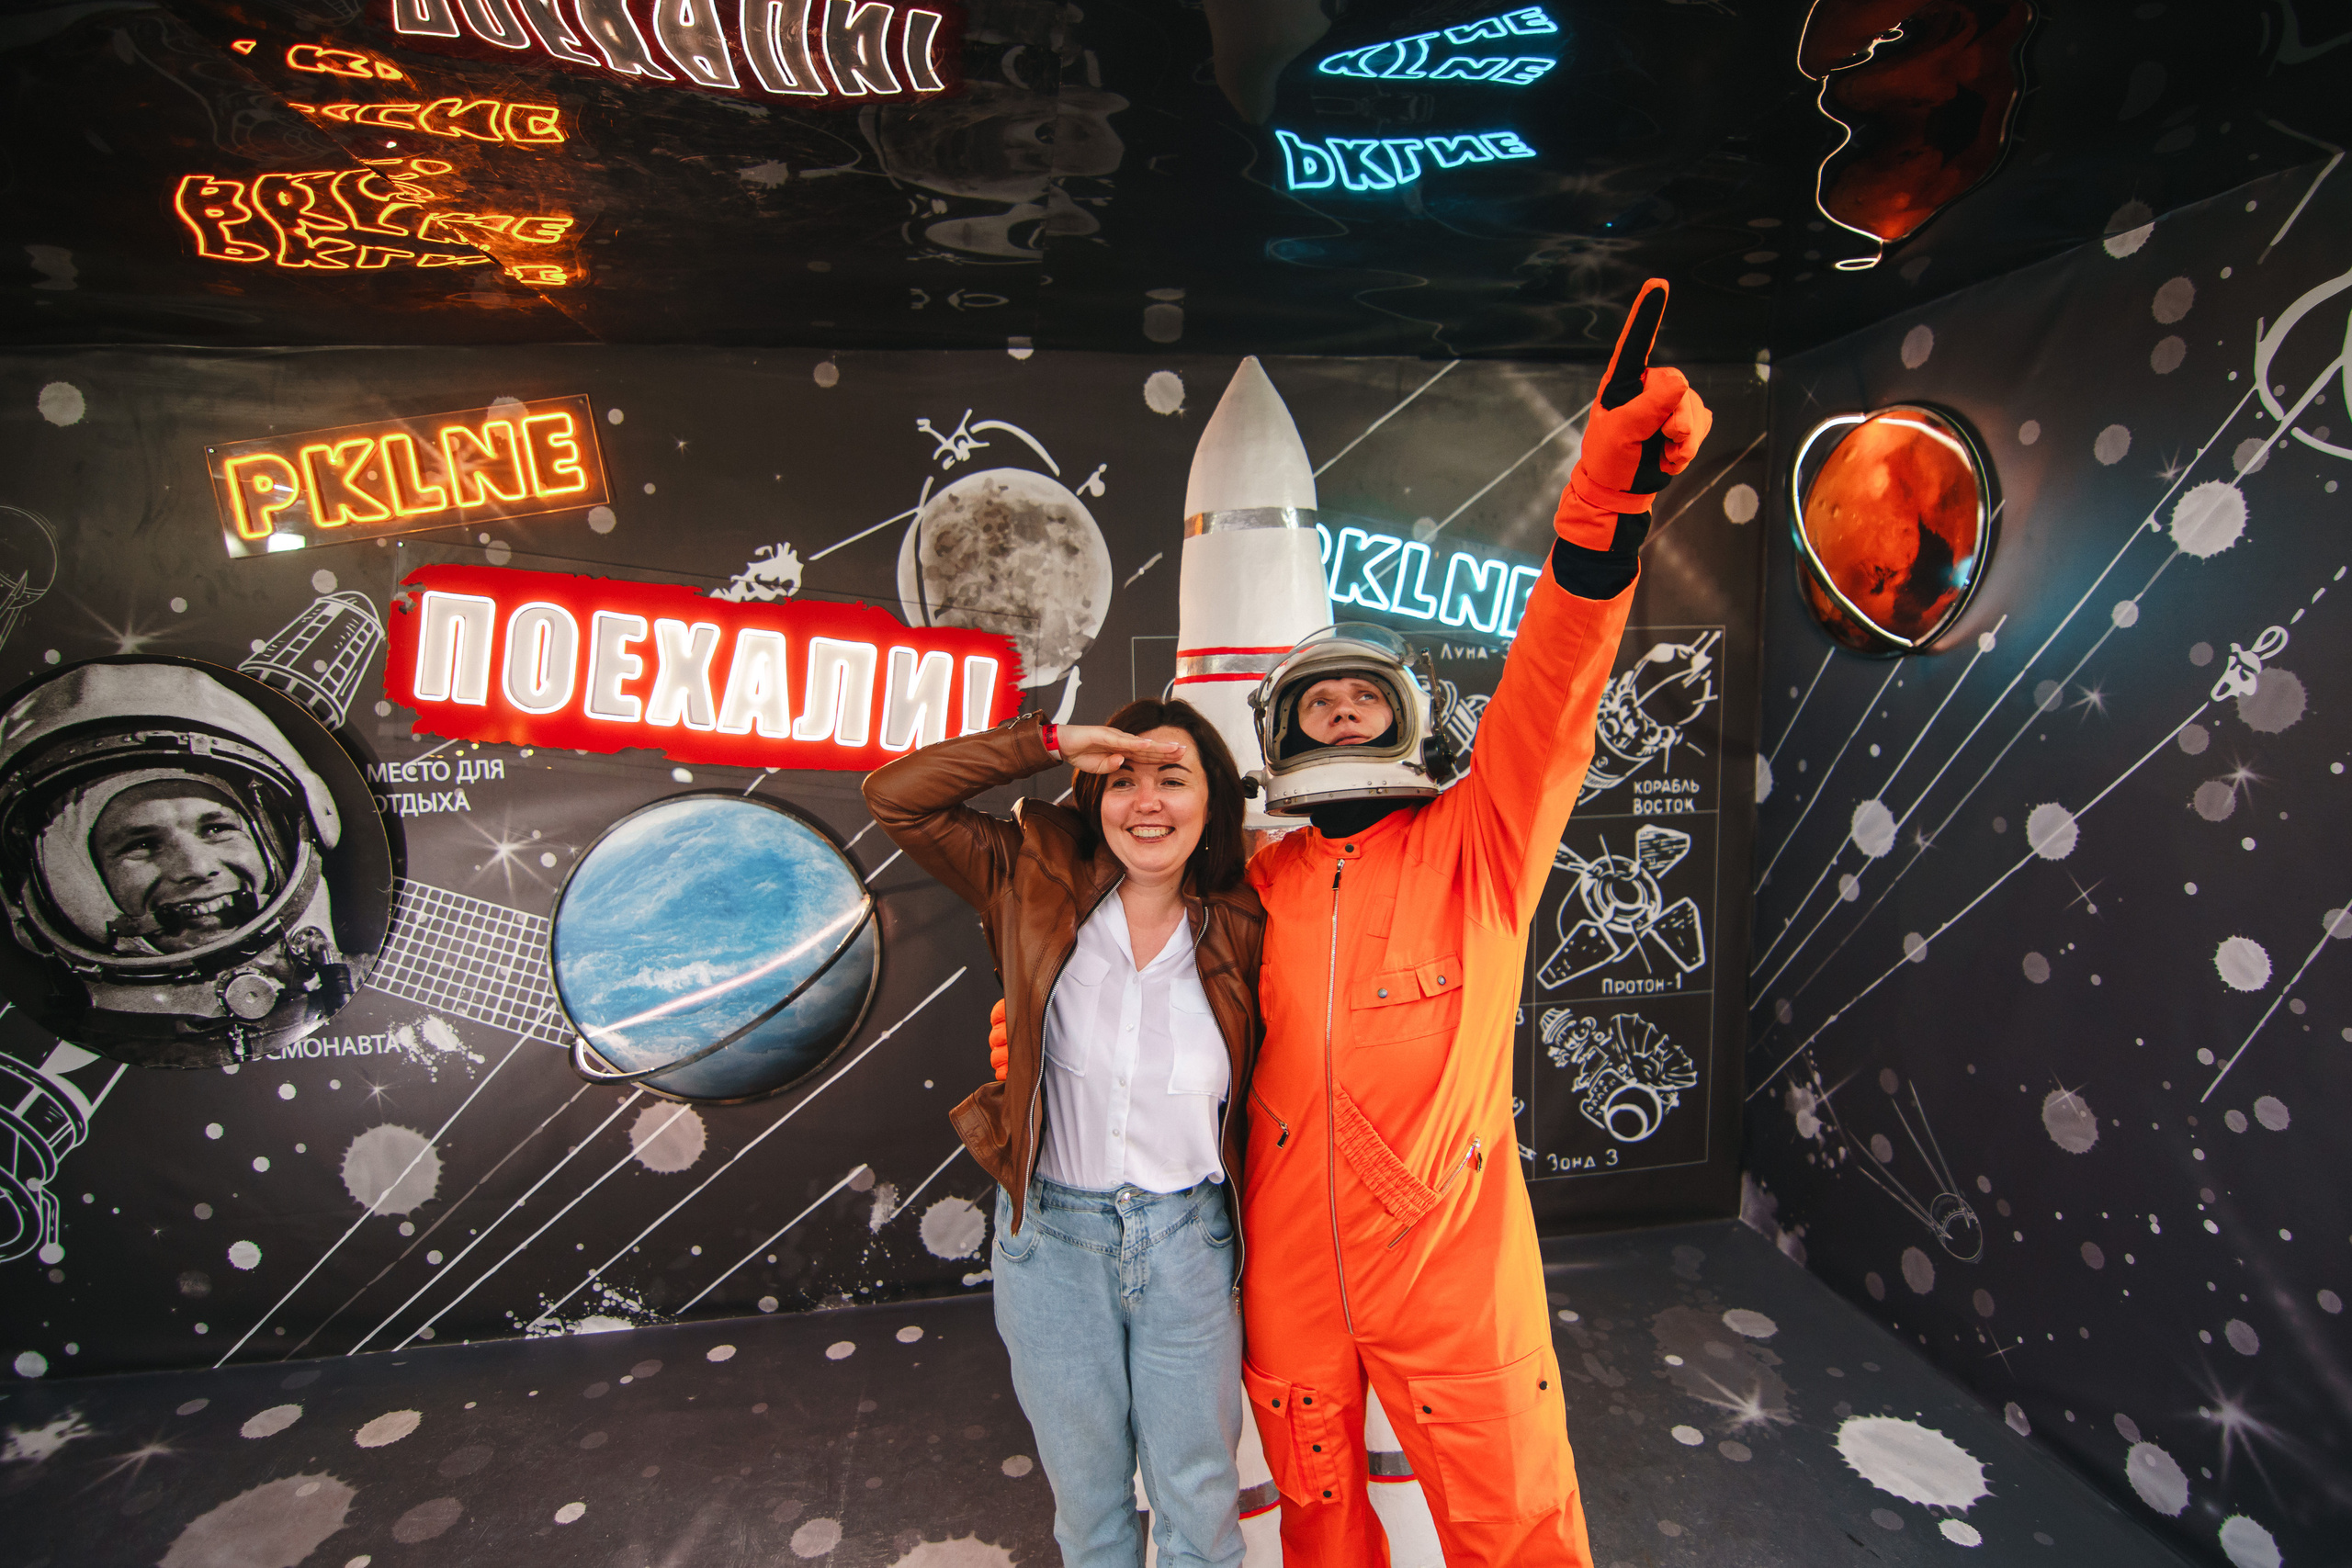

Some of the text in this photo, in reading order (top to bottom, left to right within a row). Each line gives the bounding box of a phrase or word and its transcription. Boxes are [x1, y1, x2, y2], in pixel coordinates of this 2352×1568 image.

[224, 412, 588, 540] PKLNE
[1316, 522, 1543, 637] KLNE
[413, 590, 999, 751] ПОЕХАЛИ!
[368, 759, 505, 784] МЕСТО ДЛЯ
[1633, 778, 1701, 795] КОРАБЛЬ
